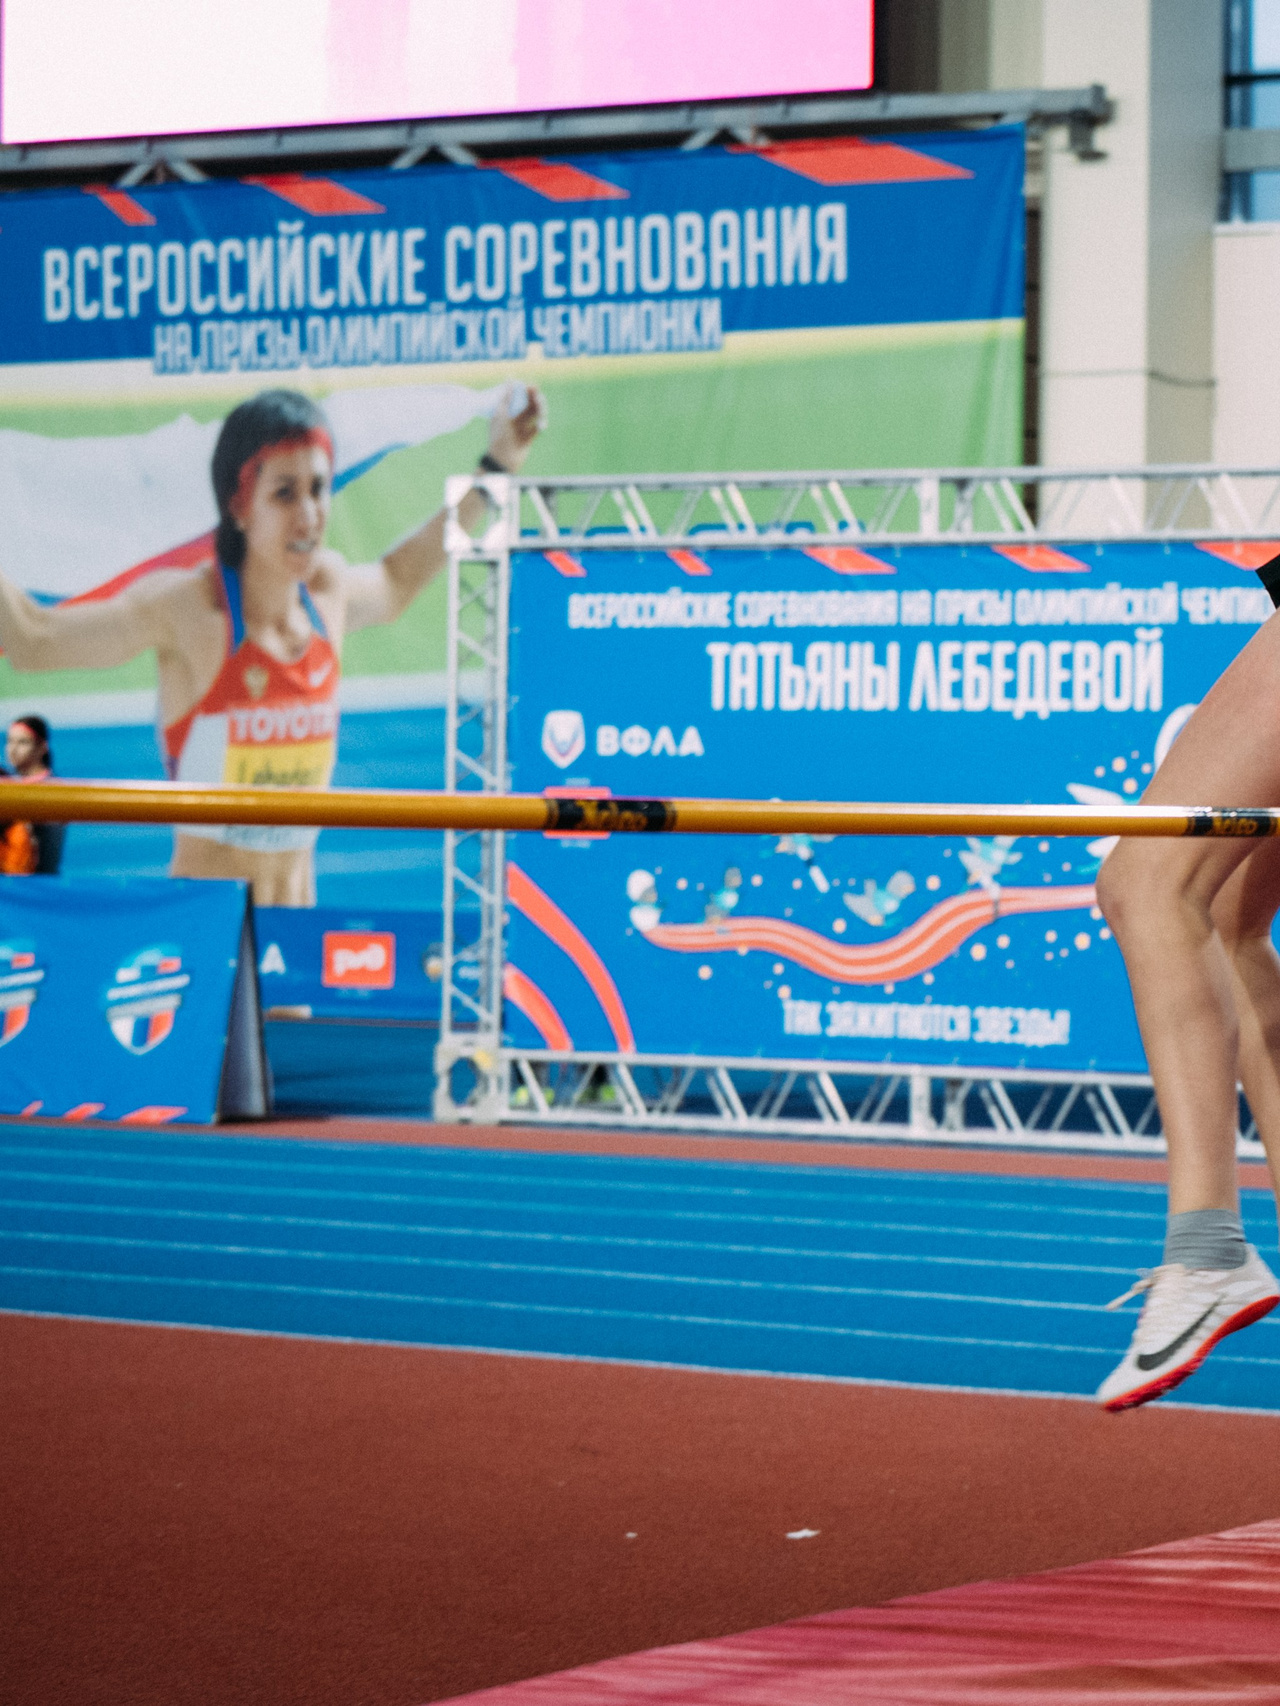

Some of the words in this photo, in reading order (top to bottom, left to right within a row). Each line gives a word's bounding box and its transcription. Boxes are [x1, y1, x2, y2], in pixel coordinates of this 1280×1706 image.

[43, 221, 428, 323] ВСЕРОССИЙСКИЕ
[443, 202, 849, 304] СОРЕВНОВАНИЯ
[154, 320, 193, 375] НА
[200, 316, 301, 373] ПРИЗЫ
[306, 300, 526, 369] ОЛИМПИЙСКОЙ
[532, 297, 722, 357] ЧЕМПИОНКИ
[706, 641, 900, 712] ТАТЬЯНЫ
[908, 627, 1163, 720] ЛЕБЕДЕВОЙ
[596, 724, 705, 757] ВФЛА
